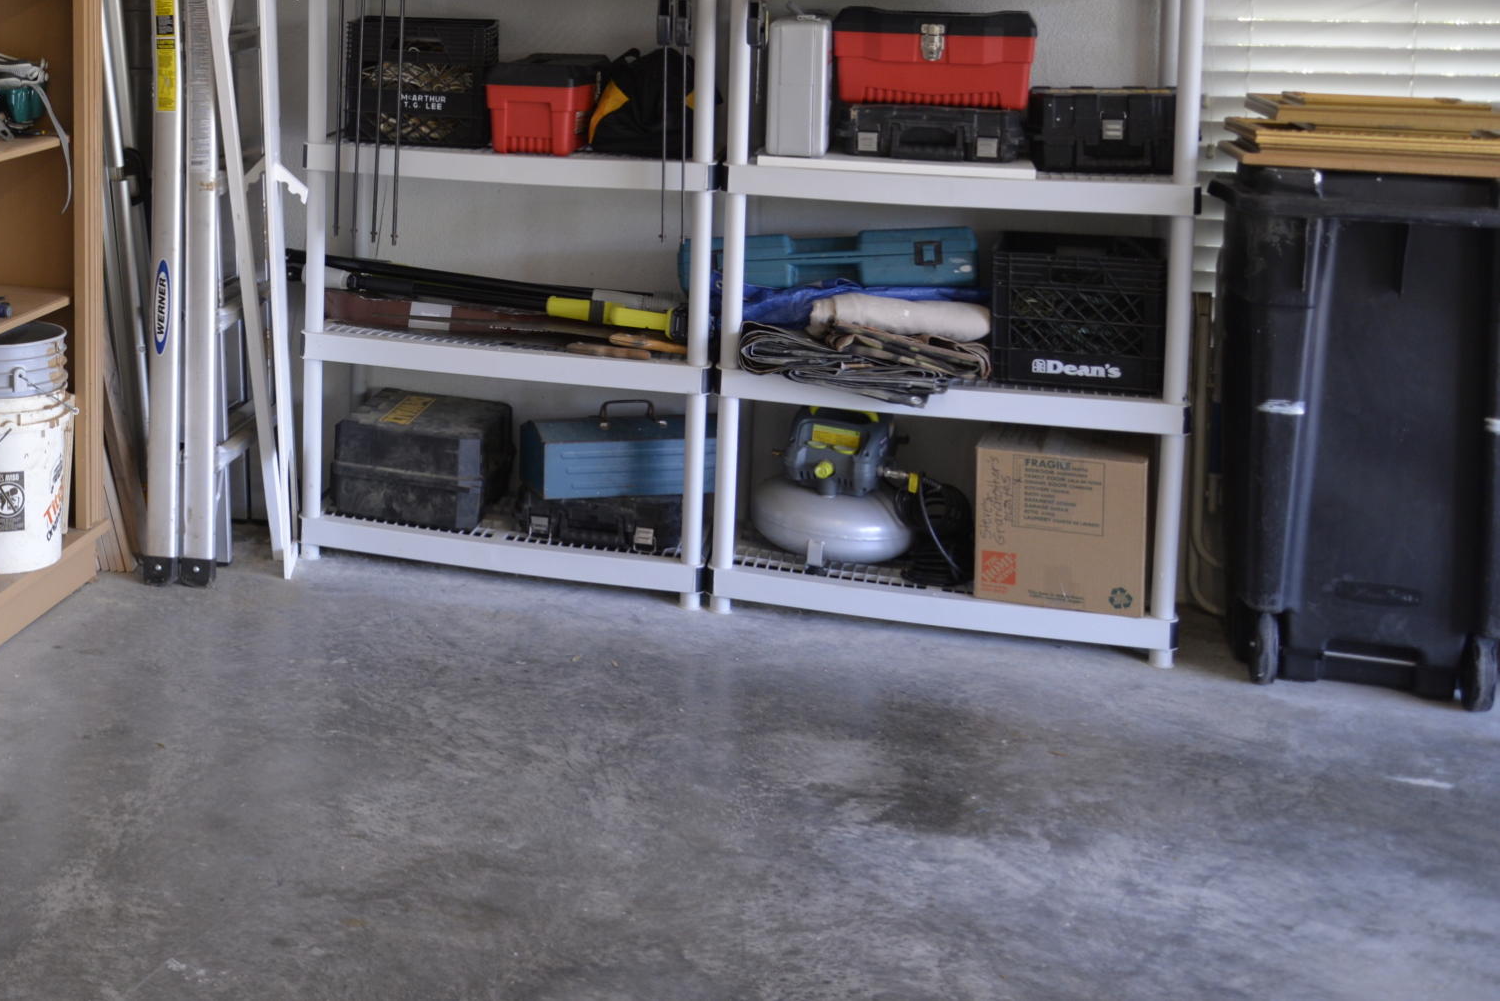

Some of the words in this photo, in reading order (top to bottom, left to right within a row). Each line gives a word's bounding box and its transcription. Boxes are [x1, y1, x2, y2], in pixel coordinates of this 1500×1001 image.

[425, 102, 443, 110] LEE
[156, 277, 167, 335] WERNER
[1046, 360, 1122, 378] Dean's
